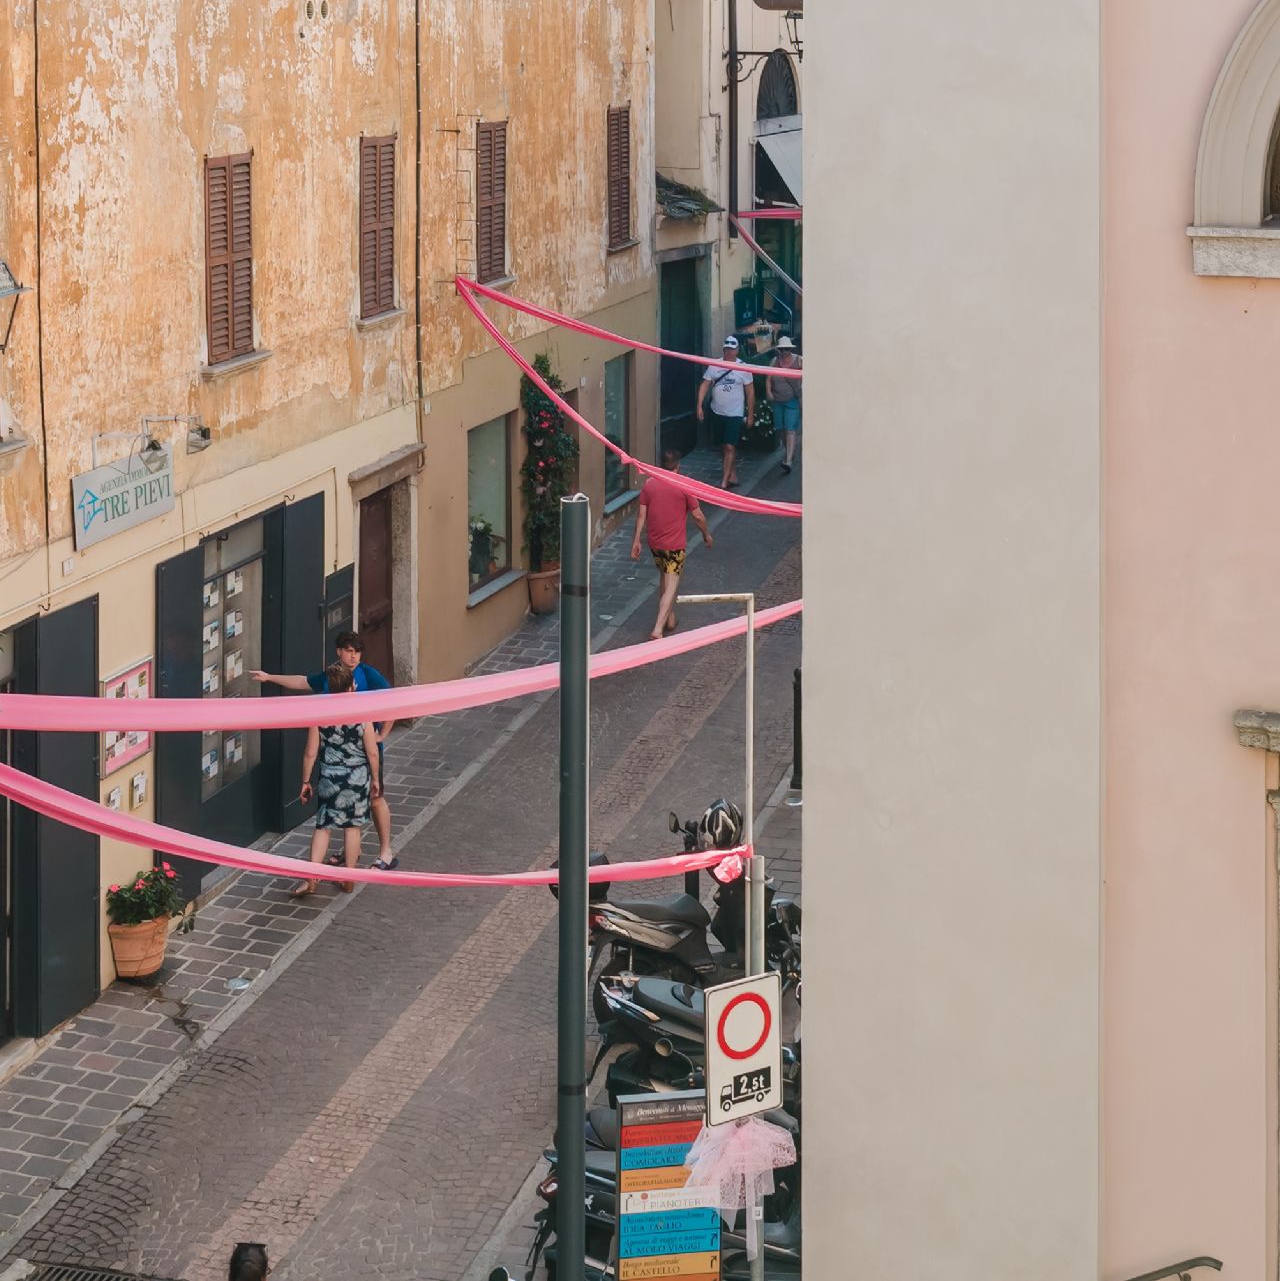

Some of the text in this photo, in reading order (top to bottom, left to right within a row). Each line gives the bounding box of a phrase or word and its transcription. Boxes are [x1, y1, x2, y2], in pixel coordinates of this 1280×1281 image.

[100, 474, 128, 494] AGENZIA
[101, 474, 171, 523] TRE PIEVI
[632, 1266, 680, 1277] CASTELLO
